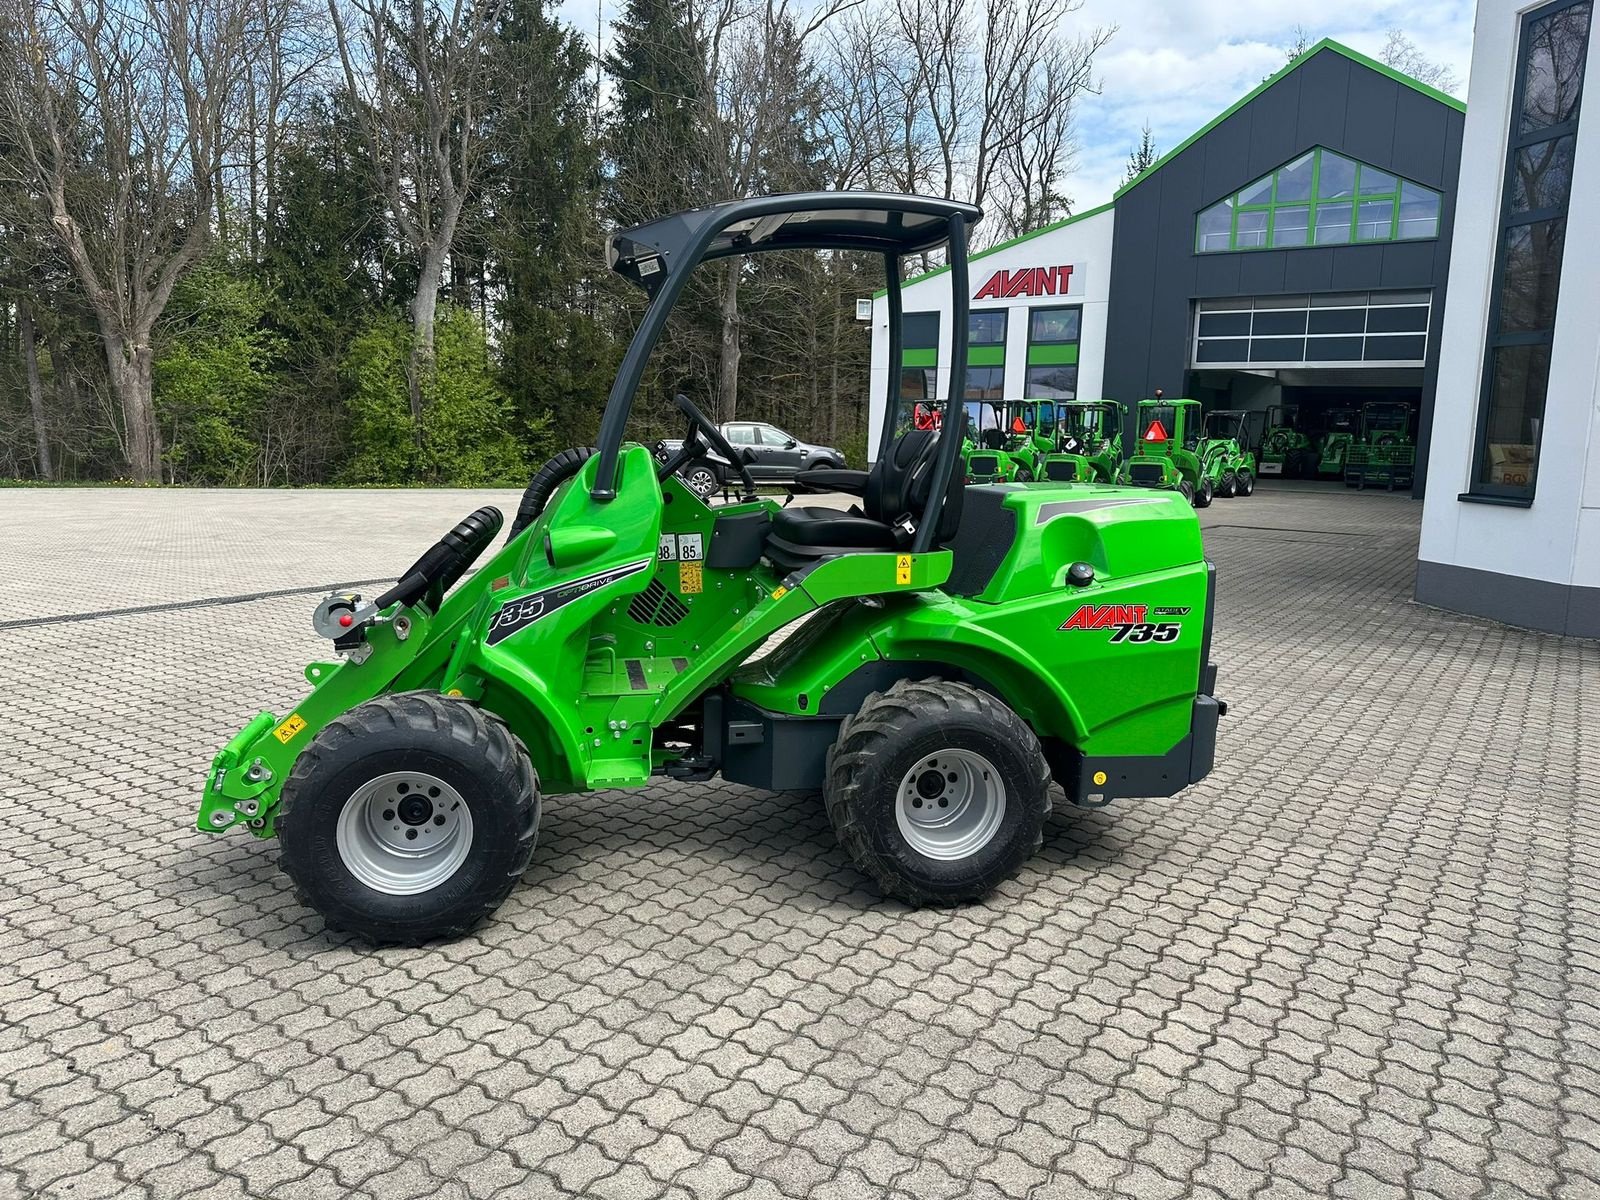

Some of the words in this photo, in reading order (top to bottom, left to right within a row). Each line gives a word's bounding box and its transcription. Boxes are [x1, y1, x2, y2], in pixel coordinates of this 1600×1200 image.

[972, 265, 1074, 300] AVANT
[682, 545, 696, 559] 85
[557, 576, 614, 599] OPTIDRIVE
[487, 595, 545, 631] 735
[1058, 604, 1148, 630] AVANT
[1109, 623, 1181, 643] 735
